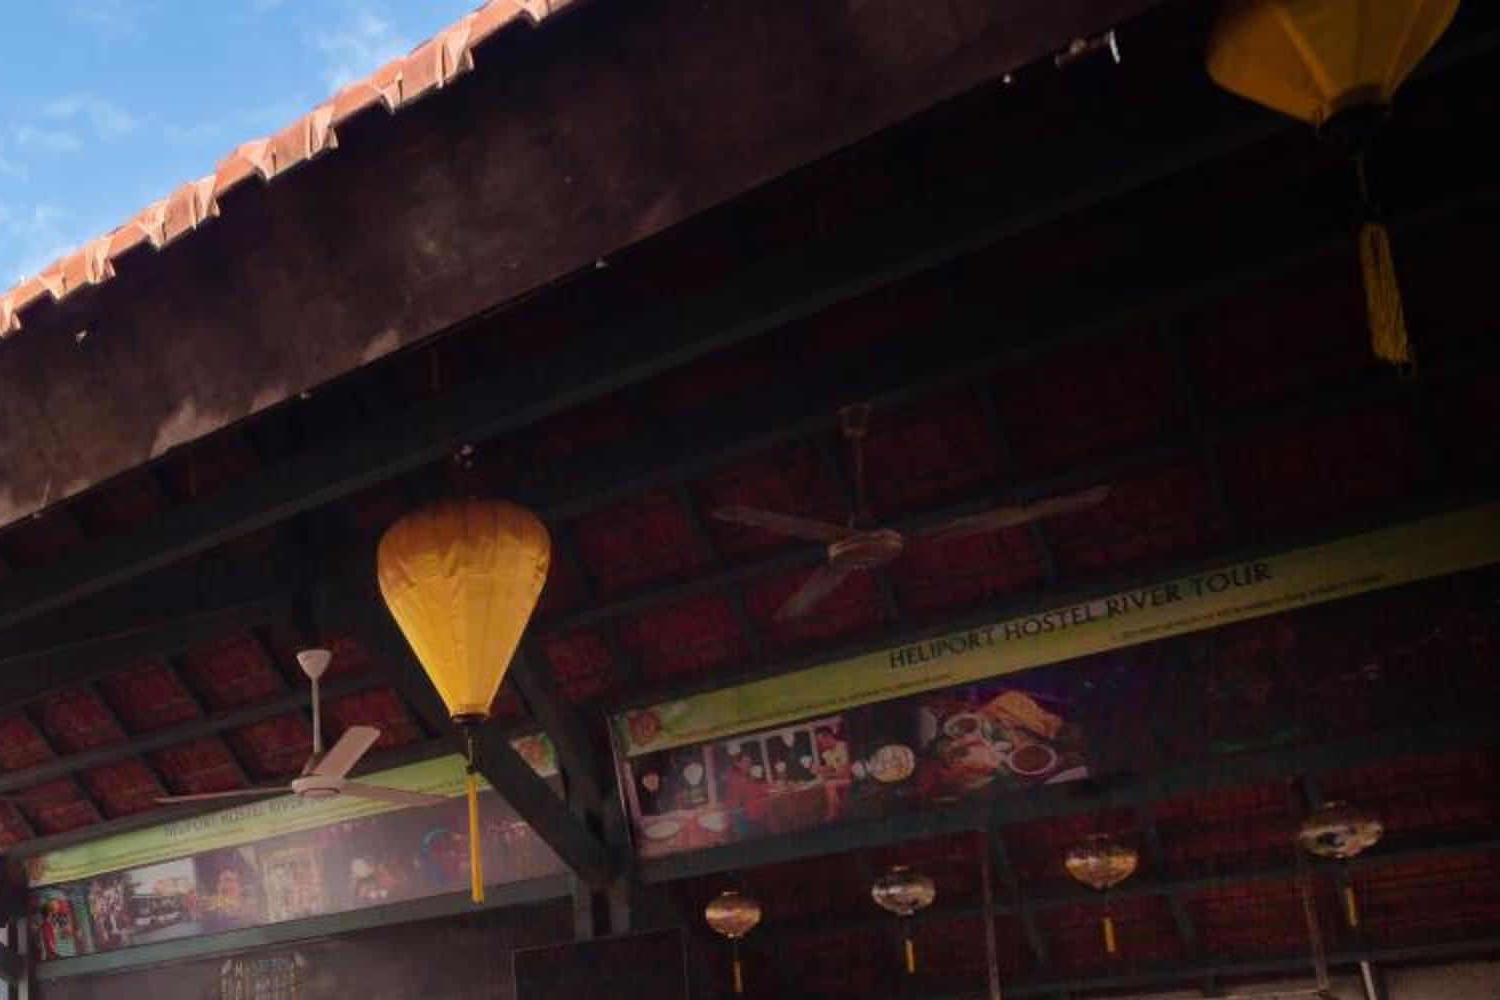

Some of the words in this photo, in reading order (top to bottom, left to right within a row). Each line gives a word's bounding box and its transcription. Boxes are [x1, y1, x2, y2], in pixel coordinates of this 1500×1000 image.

[888, 627, 997, 670] HELIPORT
[1004, 602, 1097, 642] HOSTEL
[1106, 583, 1183, 618] RIVER
[1190, 562, 1273, 598] TOUR
